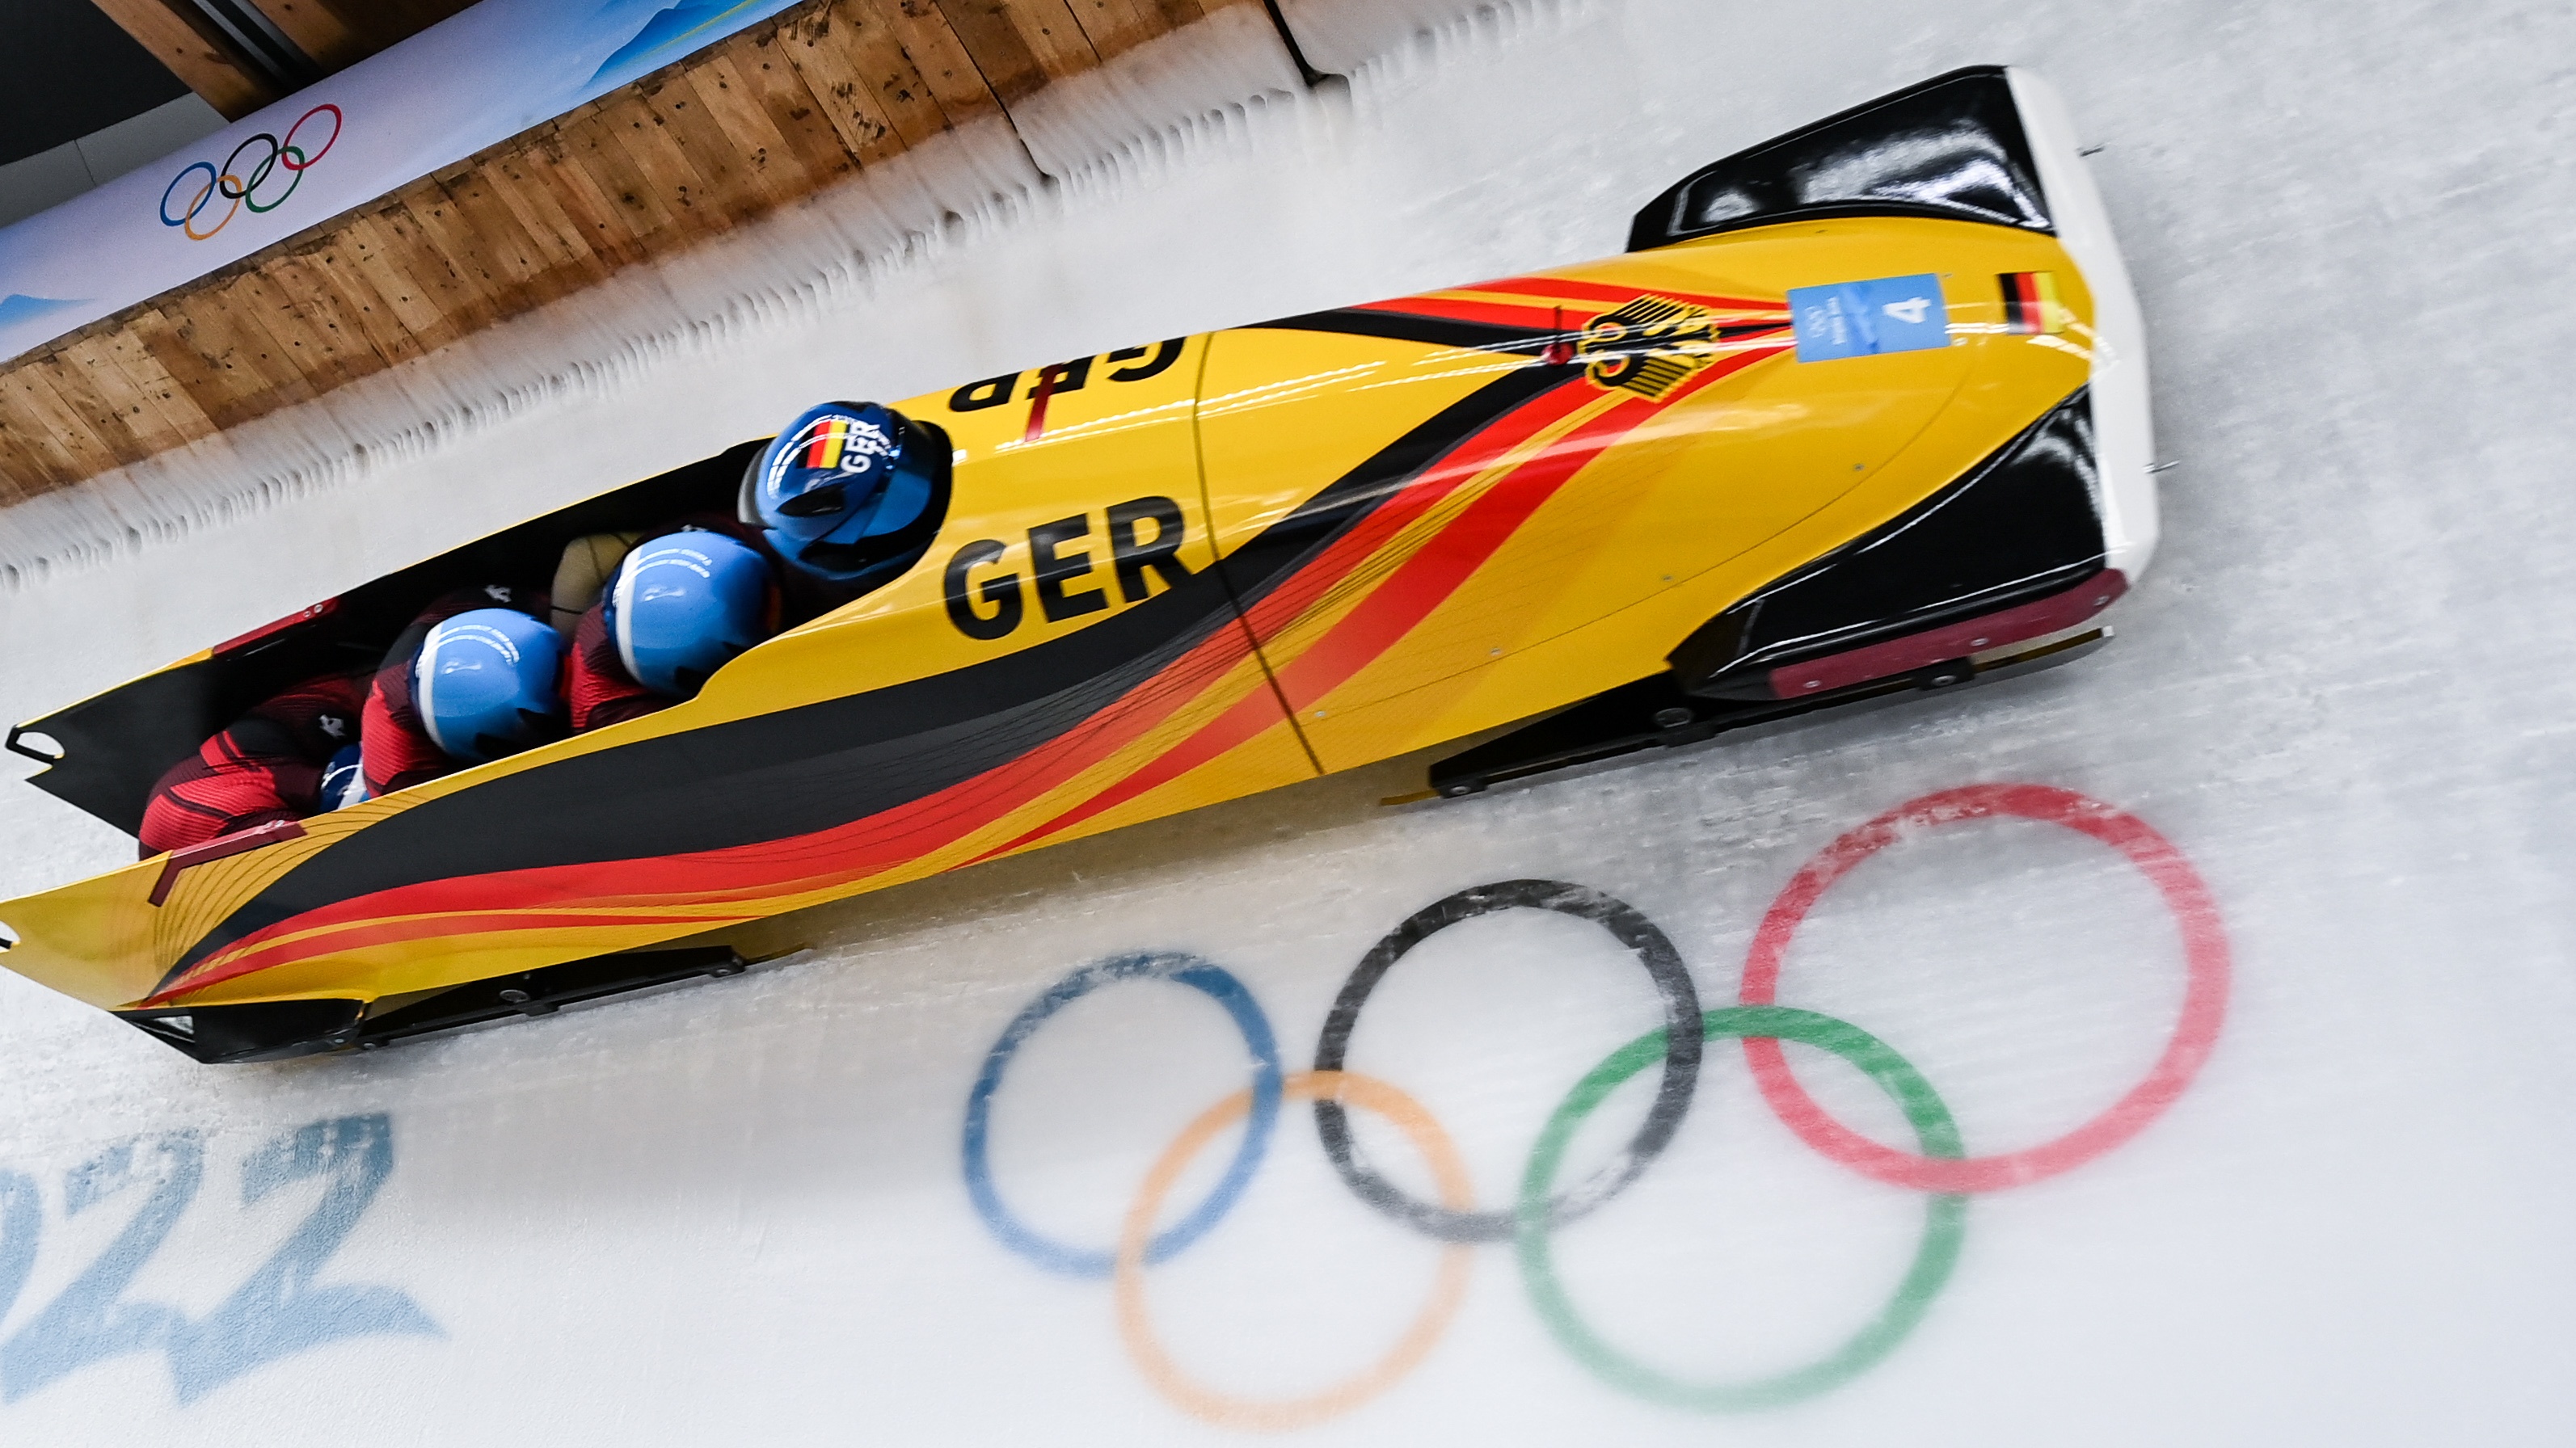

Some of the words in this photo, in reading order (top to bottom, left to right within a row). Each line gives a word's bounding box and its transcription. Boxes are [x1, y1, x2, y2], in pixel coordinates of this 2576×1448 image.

[1882, 296, 1932, 324] 4
[841, 420, 880, 474] GER
[943, 495, 1193, 640] GER
